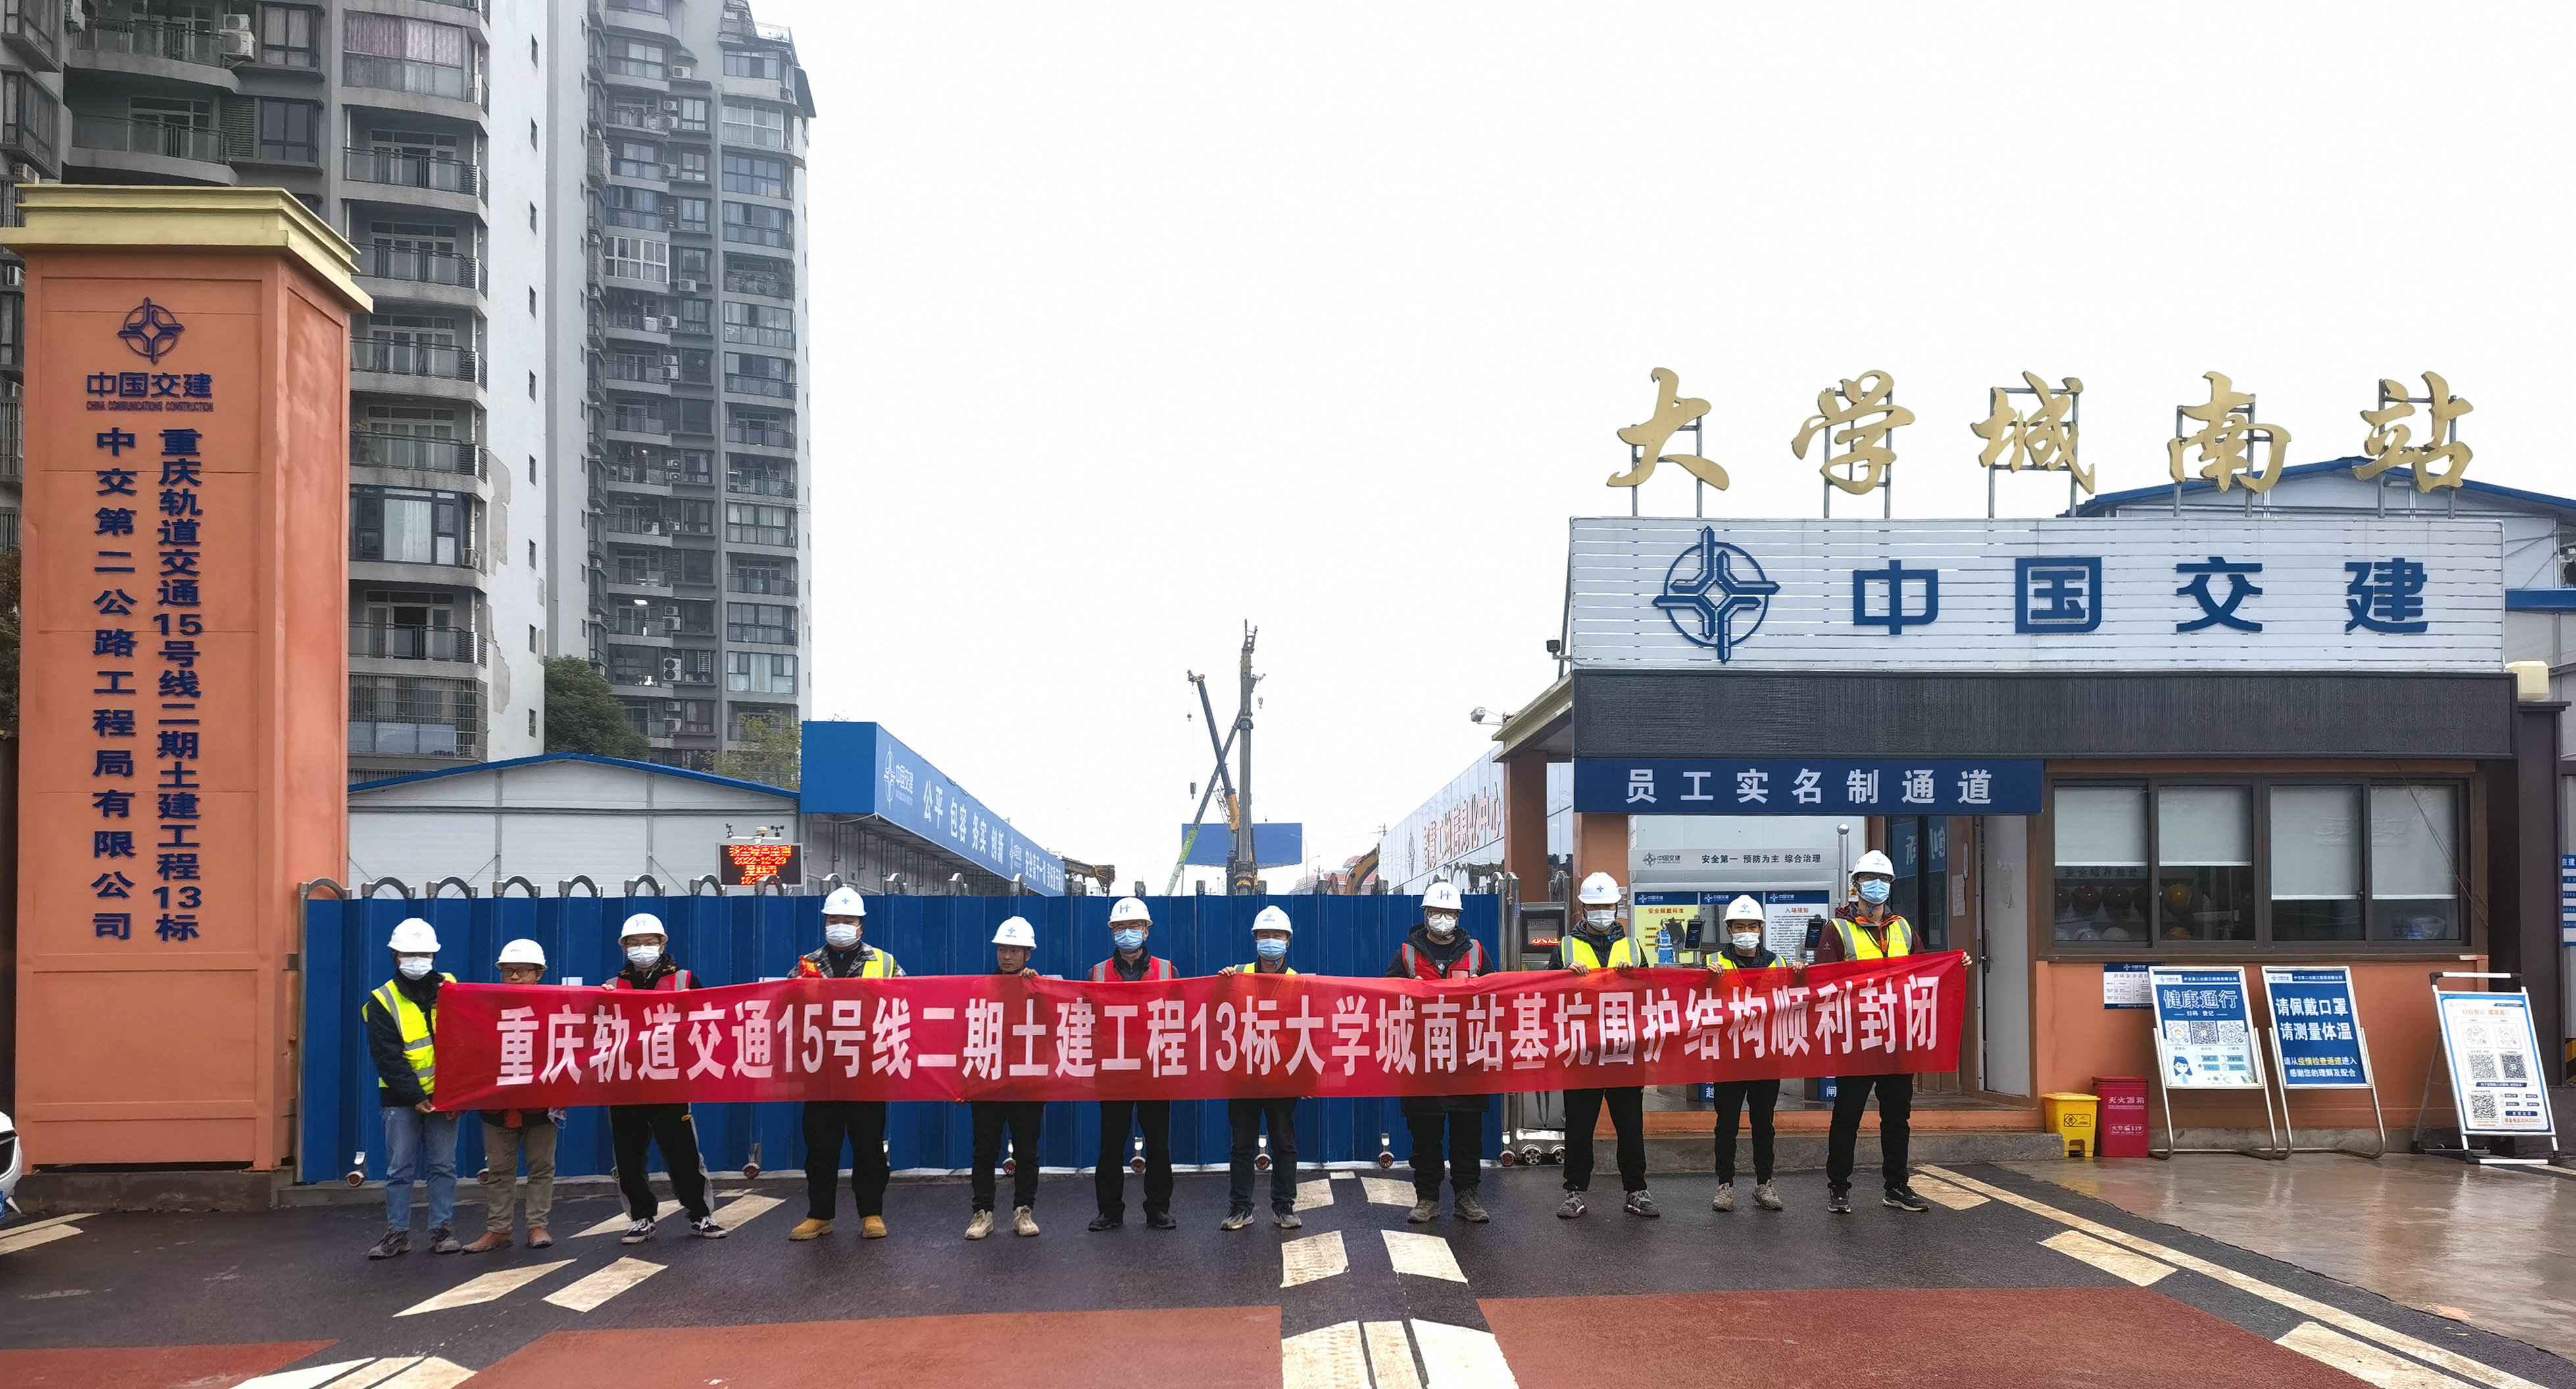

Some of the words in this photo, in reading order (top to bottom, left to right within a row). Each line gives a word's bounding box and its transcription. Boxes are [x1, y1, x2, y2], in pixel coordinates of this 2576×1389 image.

[87, 372, 213, 398] 中国交建
[87, 401, 105, 411] CHINA
[1606, 367, 2473, 495] 大学城南站
[1852, 556, 2428, 635] 中国交建
[91, 427, 137, 940] 中交第二公路工程局有限公司
[153, 429, 203, 942] 重庆轨道交通15号线二期土建工程13标
[1625, 768, 1993, 804] 员工实名制通道
[924, 780, 943, 829] 公平
[950, 797, 967, 843] 包容
[972, 812, 987, 854] 务实
[1702, 854, 1738, 864] 安全第一
[1743, 854, 1779, 864] 预防为主
[1784, 854, 1821, 864] 综合治理
[2163, 990, 2238, 1010] 健康通行
[2275, 997, 2348, 1017] 请佩戴口罩
[496, 974, 1940, 1086] 重庆轨道交通15号线二期土建工程13标大学城南站基坑围护结构顺利封闭
[2280, 1021, 2353, 1041] 请测量体温
[2284, 1057, 2357, 1065] 请从疫情检查通道进入
[2289, 1069, 2356, 1077] 感谢您的理解及配合
